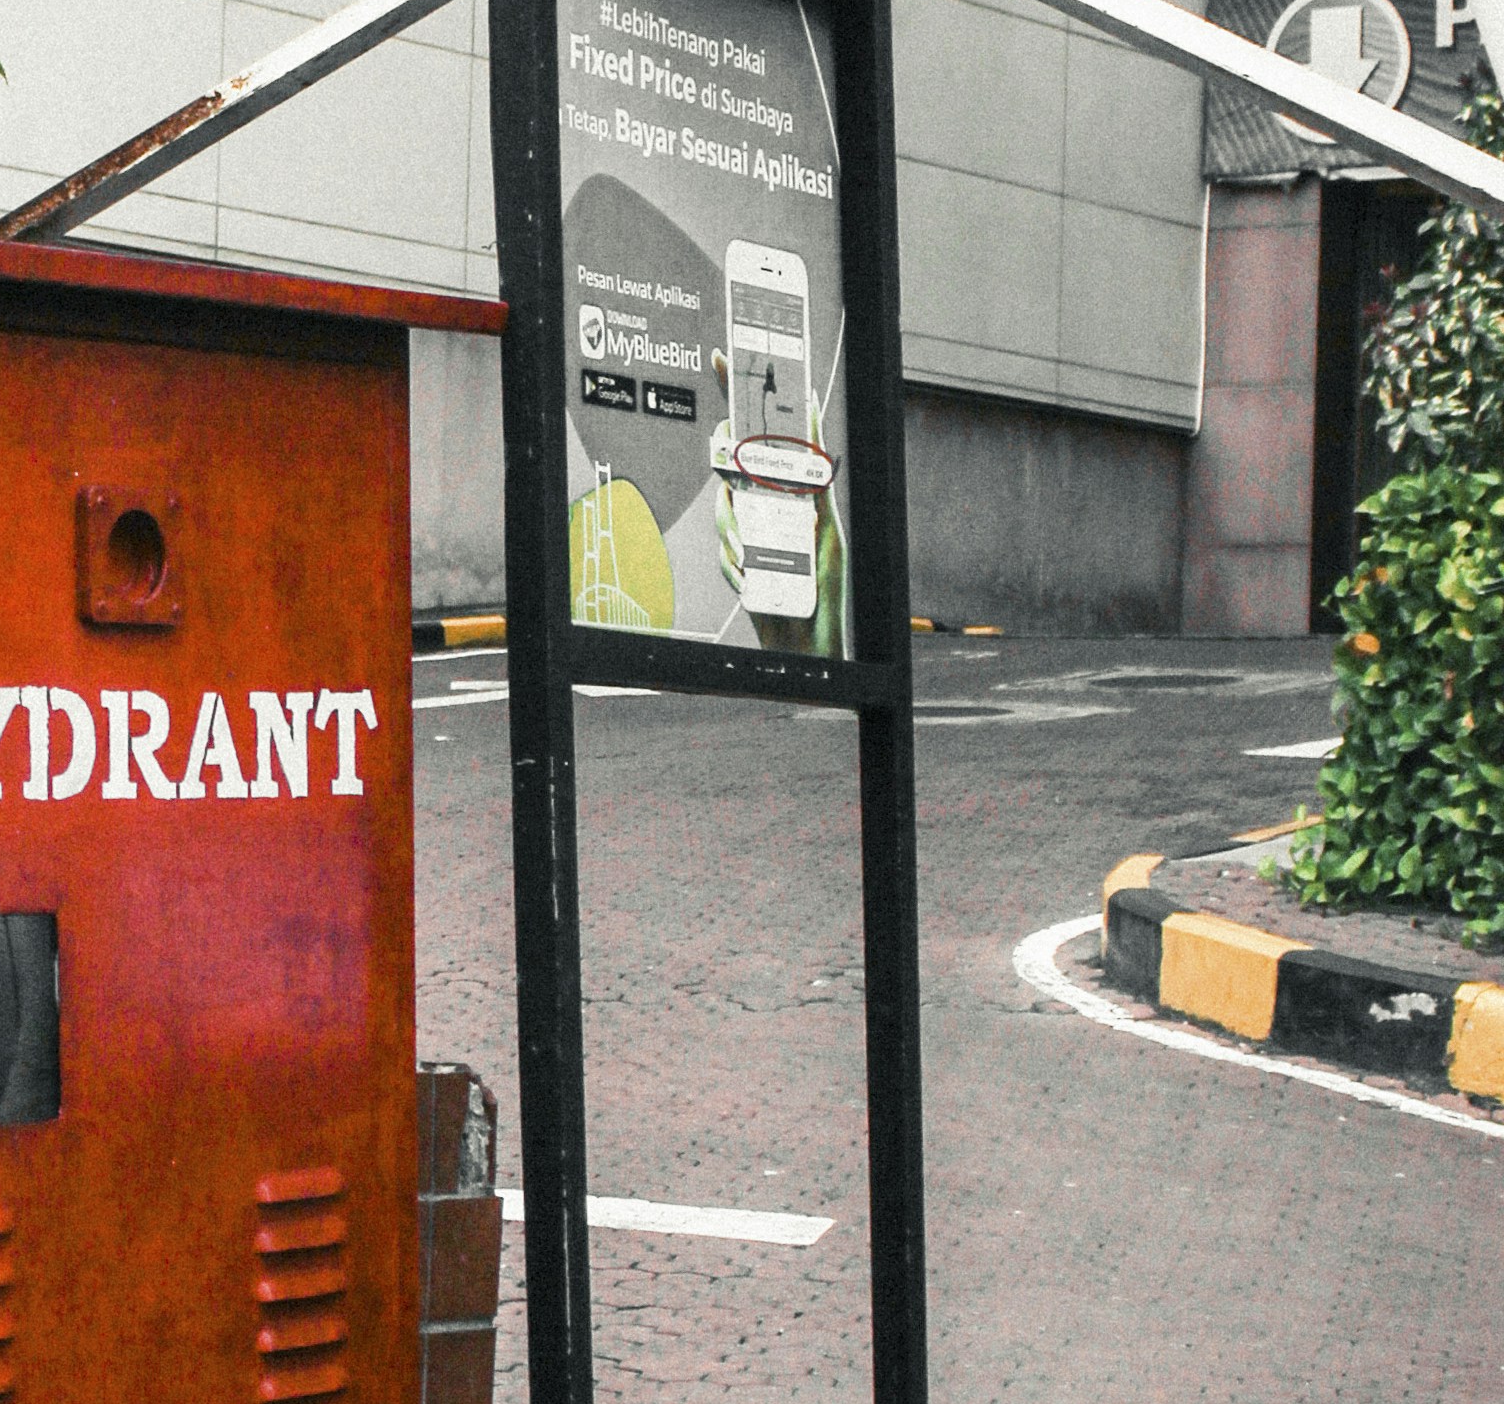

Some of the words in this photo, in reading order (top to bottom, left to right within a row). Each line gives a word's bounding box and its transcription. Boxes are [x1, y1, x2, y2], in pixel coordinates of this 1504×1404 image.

[600, 0, 718, 67] #LebihTenang
[723, 38, 766, 76] Pakai
[569, 32, 634, 86] Fixed
[640, 55, 697, 104] Price
[701, 82, 717, 111] di
[721, 88, 794, 137] Surabaya
[615, 108, 677, 157] Bayar
[681, 127, 748, 176] Sesuai
[753, 148, 833, 199] Aplikasi
[578, 264, 614, 291] Pesan
[617, 274, 653, 300] Lewat
[655, 283, 701, 310] Aplikasi
[607, 328, 702, 372] MyBlueBird
